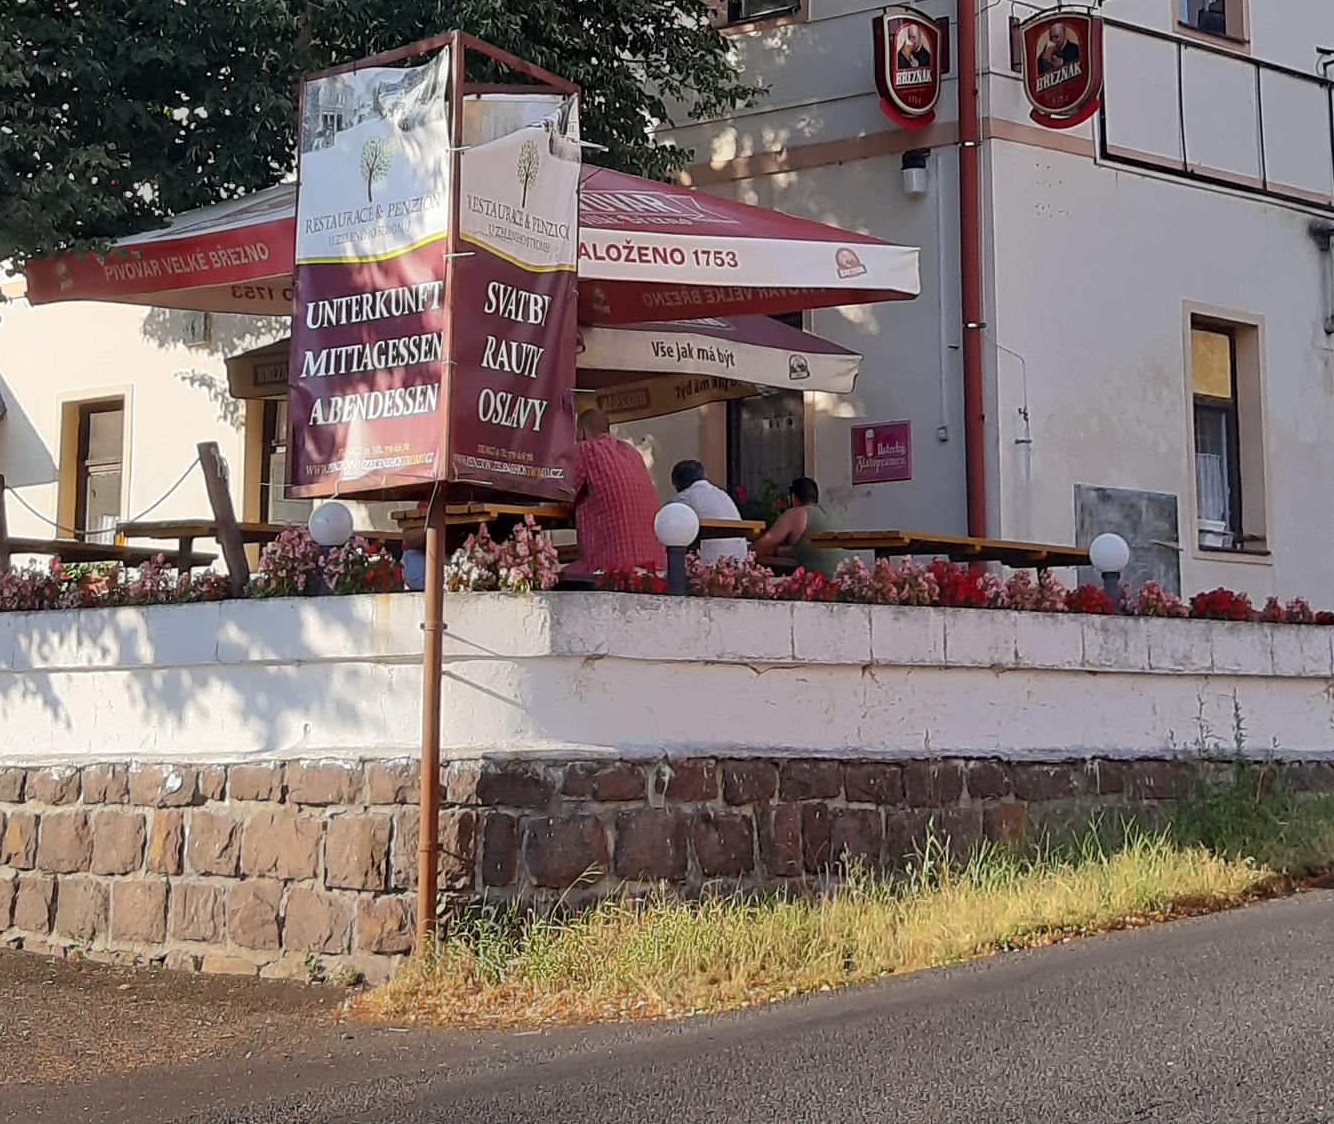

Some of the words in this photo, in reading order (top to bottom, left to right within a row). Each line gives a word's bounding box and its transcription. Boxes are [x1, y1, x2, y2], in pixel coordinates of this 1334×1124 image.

[305, 206, 375, 234] RESTAURACE
[374, 204, 385, 221] &
[387, 192, 442, 218] PENZION
[524, 213, 532, 230] &
[104, 258, 162, 282] PIVOVAR
[161, 248, 209, 274] VELKÉ
[209, 242, 269, 269] BŘEZNO
[578, 239, 686, 266] ALOŽENO
[692, 249, 739, 268] 1753
[306, 281, 444, 329] UNTERKUNFT
[299, 332, 444, 378] MITTAGESSEN
[481, 335, 545, 378] RAUTY
[651, 341, 674, 358] Vše
[675, 341, 694, 363] jak
[697, 346, 716, 362] má
[716, 347, 736, 369] být
[309, 383, 439, 425] ABENDESSEN
[478, 388, 549, 432] OSLAVY
